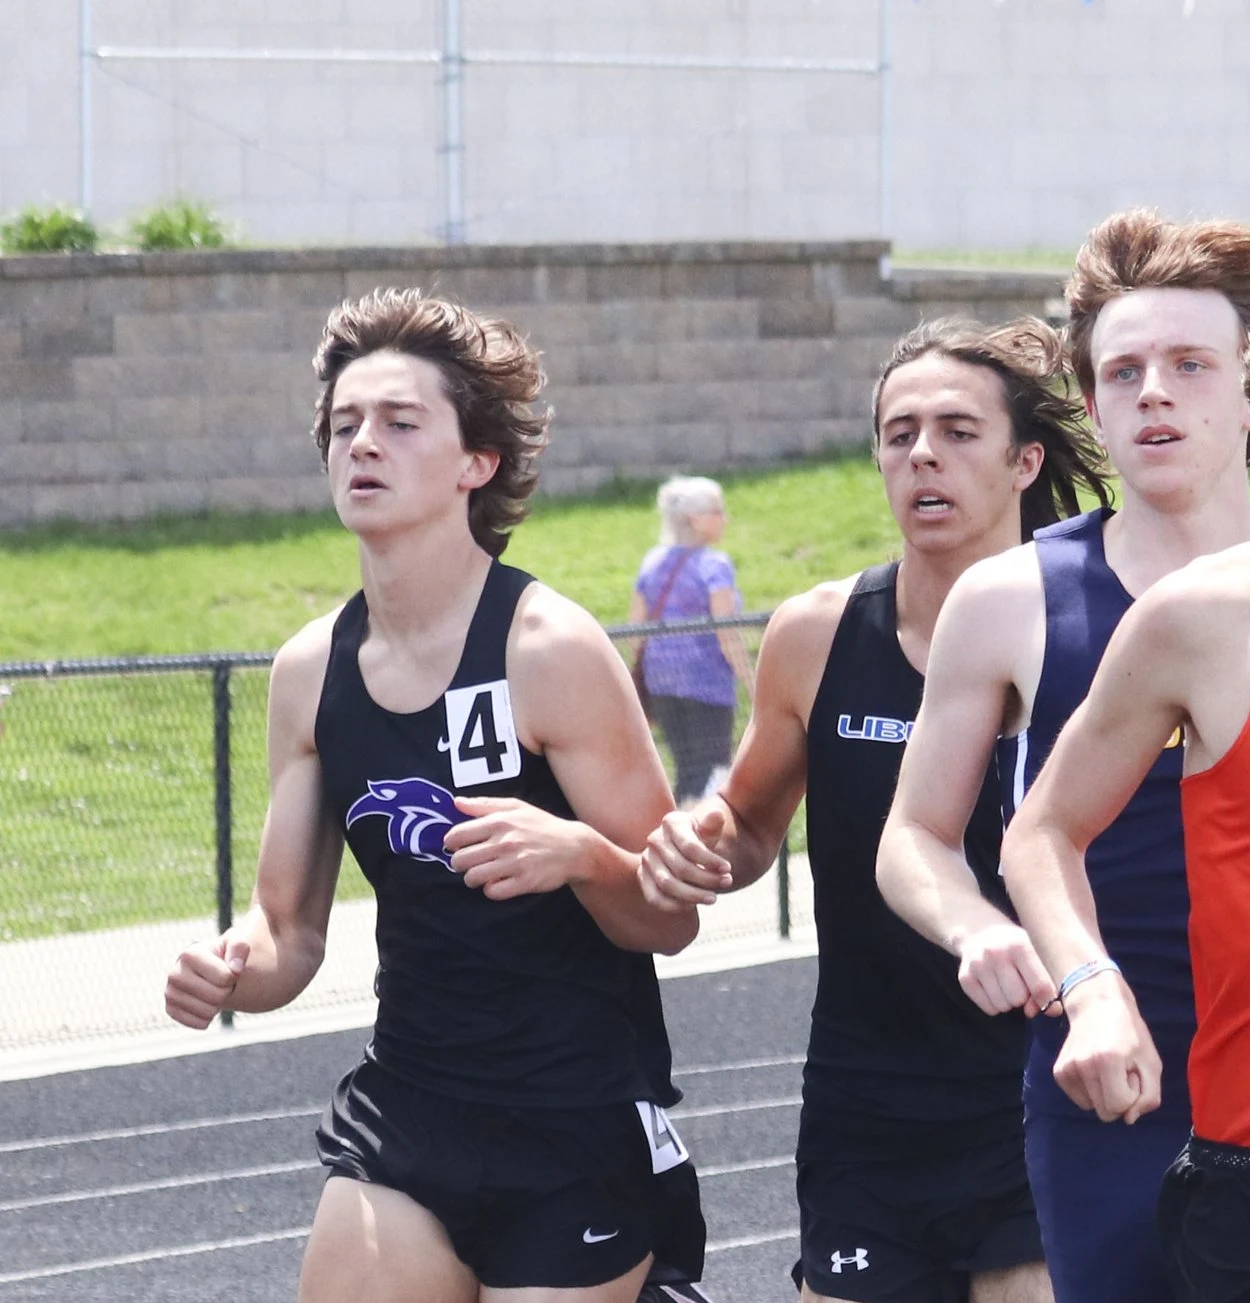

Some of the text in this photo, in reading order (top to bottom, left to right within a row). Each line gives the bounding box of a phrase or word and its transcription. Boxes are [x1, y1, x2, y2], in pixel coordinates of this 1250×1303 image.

[458, 690, 508, 775] 4
[837, 714, 915, 744] LIB
[648, 1102, 683, 1157] 4
